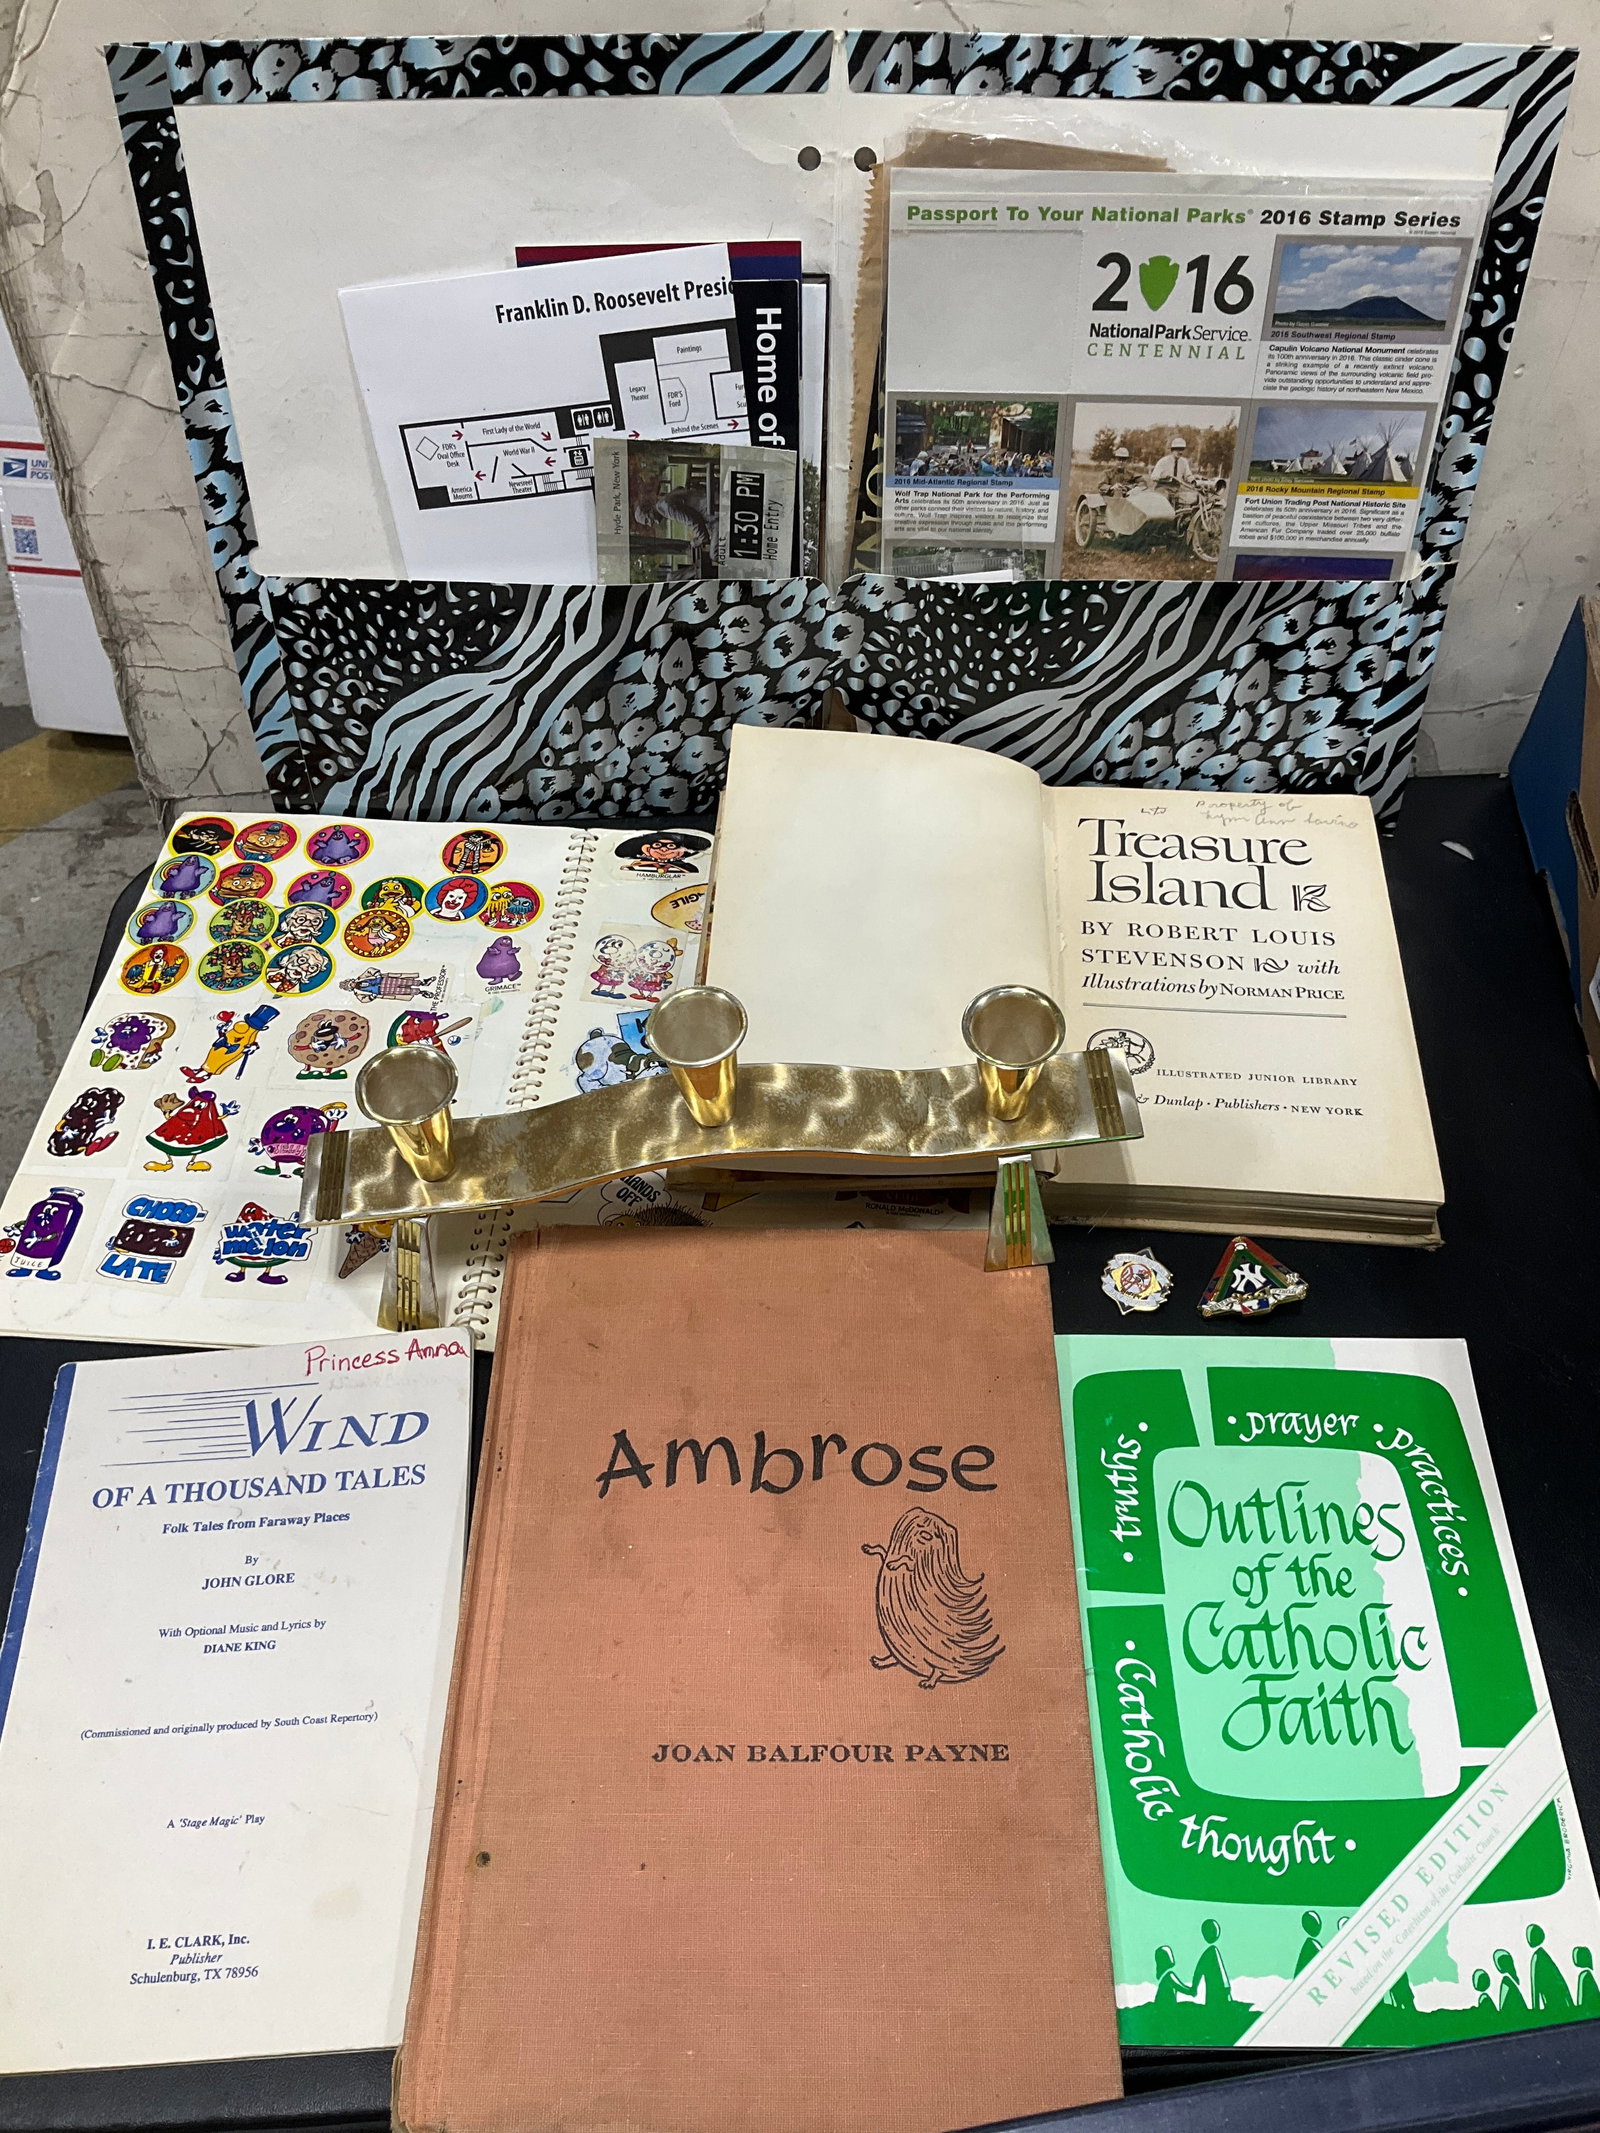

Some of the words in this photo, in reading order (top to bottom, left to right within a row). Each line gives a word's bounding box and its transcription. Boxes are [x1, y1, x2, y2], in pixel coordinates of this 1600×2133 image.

[907, 205, 998, 224] Passport
[1006, 206, 1029, 221] To
[1038, 206, 1084, 222] Your
[1092, 206, 1179, 223] National
[1260, 209, 1312, 225] 2016
[1319, 210, 1386, 230] Stamp
[1394, 210, 1461, 228] Series
[495, 299, 569, 324] Franklin
[572, 294, 591, 316] D.
[595, 282, 680, 313] Roosevelt
[684, 275, 734, 301] Presi
[1271, 330, 1289, 338] 2016
[1291, 331, 1332, 339] Southwest
[1334, 332, 1368, 341] Regional
[1371, 333, 1396, 342] Stamp
[677, 345, 702, 354] Paintings
[755, 307, 783, 403] Home
[1087, 342, 1245, 360] CENTENNIAL
[629, 386, 646, 394] Legacy
[482, 428, 494, 436] First
[495, 426, 508, 435] Lady
[509, 425, 515, 433] of
[525, 422, 541, 430] World
[671, 425, 689, 434] Behind
[701, 423, 719, 431] Scenes
[757, 415, 786, 449] of
[437, 452, 449, 461] Oval
[449, 451, 465, 459] Office
[503, 449, 518, 457] World
[611, 451, 620, 471] York
[451, 486, 472, 494] America
[509, 480, 533, 488] Newsreel
[511, 487, 532, 495] Theater
[736, 472, 761, 498] PM
[764, 499, 783, 531] Entry
[733, 510, 759, 557] 1:30
[719, 536, 727, 566] Adult
[763, 537, 778, 561] Home
[1077, 818, 1313, 866] Treasure
[1087, 860, 1277, 911] Island
[1081, 921, 1113, 936] BY
[1128, 922, 1238, 944] ROBERT
[1252, 928, 1336, 947] LOUIS
[1082, 949, 1244, 971] STEVENSON
[1297, 959, 1340, 976] with
[1082, 974, 1196, 994] Illustrations
[1198, 979, 1219, 999] by
[1220, 982, 1293, 999] NORMAN
[1295, 986, 1345, 1000] PRICE
[1156, 1068, 1242, 1081] ILLUSTRATED
[1248, 1073, 1296, 1083] JUNIOR
[1303, 1076, 1358, 1086] LIBRARY
[1154, 1094, 1204, 1111] Dunlap
[1291, 1105, 1322, 1114] NEW
[1325, 1106, 1364, 1117] YORK
[616, 1187, 643, 1207] OFF
[865, 1202, 896, 1212] RONALD
[126, 1197, 207, 1224] CHOCO-
[14, 1256, 44, 1268] JUICE
[101, 1254, 173, 1283] LATE
[305, 1344, 400, 1377] Princess
[404, 1337, 470, 1361] Anna
[245, 1394, 430, 1457] WIND
[1239, 1410, 1360, 1442] prayer
[596, 1429, 998, 1499] Ambrose
[92, 1485, 134, 1509] OF
[137, 1489, 157, 1506] A
[166, 1471, 327, 1505] THOUSAND
[335, 1463, 427, 1491] TALES
[1101, 1433, 1142, 1544] truths
[1376, 1427, 1469, 1579] practices
[162, 1521, 189, 1534] Folk
[193, 1519, 224, 1533] Tales
[227, 1517, 256, 1530] from
[259, 1514, 310, 1529] Faraway
[314, 1510, 350, 1524] Places
[1167, 1479, 1406, 1561] Outlines
[245, 1554, 259, 1566] By
[201, 1576, 242, 1590] JOHN
[244, 1572, 296, 1587] GLORE
[1232, 1552, 1283, 1607] of
[1287, 1552, 1357, 1598] the
[158, 1627, 181, 1639] With
[184, 1625, 226, 1640] Optional
[229, 1622, 259, 1634] Music
[261, 1621, 279, 1632] and
[281, 1619, 312, 1634] Lyrics
[314, 1617, 327, 1630] by
[1182, 1602, 1432, 1674] Catholic
[203, 1642, 242, 1655] DIANE
[244, 1639, 277, 1652] KING
[1222, 1673, 1414, 1754] Faith
[80, 1726, 151, 1742] (Commissioned
[153, 1724, 170, 1735] and
[171, 1722, 215, 1737] originally
[216, 1719, 258, 1734] produced
[260, 1718, 272, 1730] by
[274, 1716, 300, 1728] South
[302, 1715, 328, 1726] Coast
[330, 1711, 378, 1725] Repertory)
[1114, 1656, 1181, 1822] Catholic
[652, 1744, 736, 1763] JOAN
[746, 1744, 895, 1763] BALFOUR
[905, 1744, 1010, 1763] PAYNE
[167, 1818, 175, 1829] A
[245, 1813, 265, 1827] Play
[1179, 1815, 1337, 1876] thought
[1306, 1894, 1409, 2008] REVISED
[1414, 1781, 1510, 1888] EDITION
[147, 1937, 156, 1950] I.
[159, 1936, 172, 1950] E.
[174, 1934, 226, 1949] CLARK,
[228, 1932, 251, 1946] Inc.
[169, 1952, 223, 1966] Publisher
[129, 1970, 201, 1985] Schulenburg,
[204, 1968, 223, 1981] TX
[225, 1965, 259, 1979] 78956
